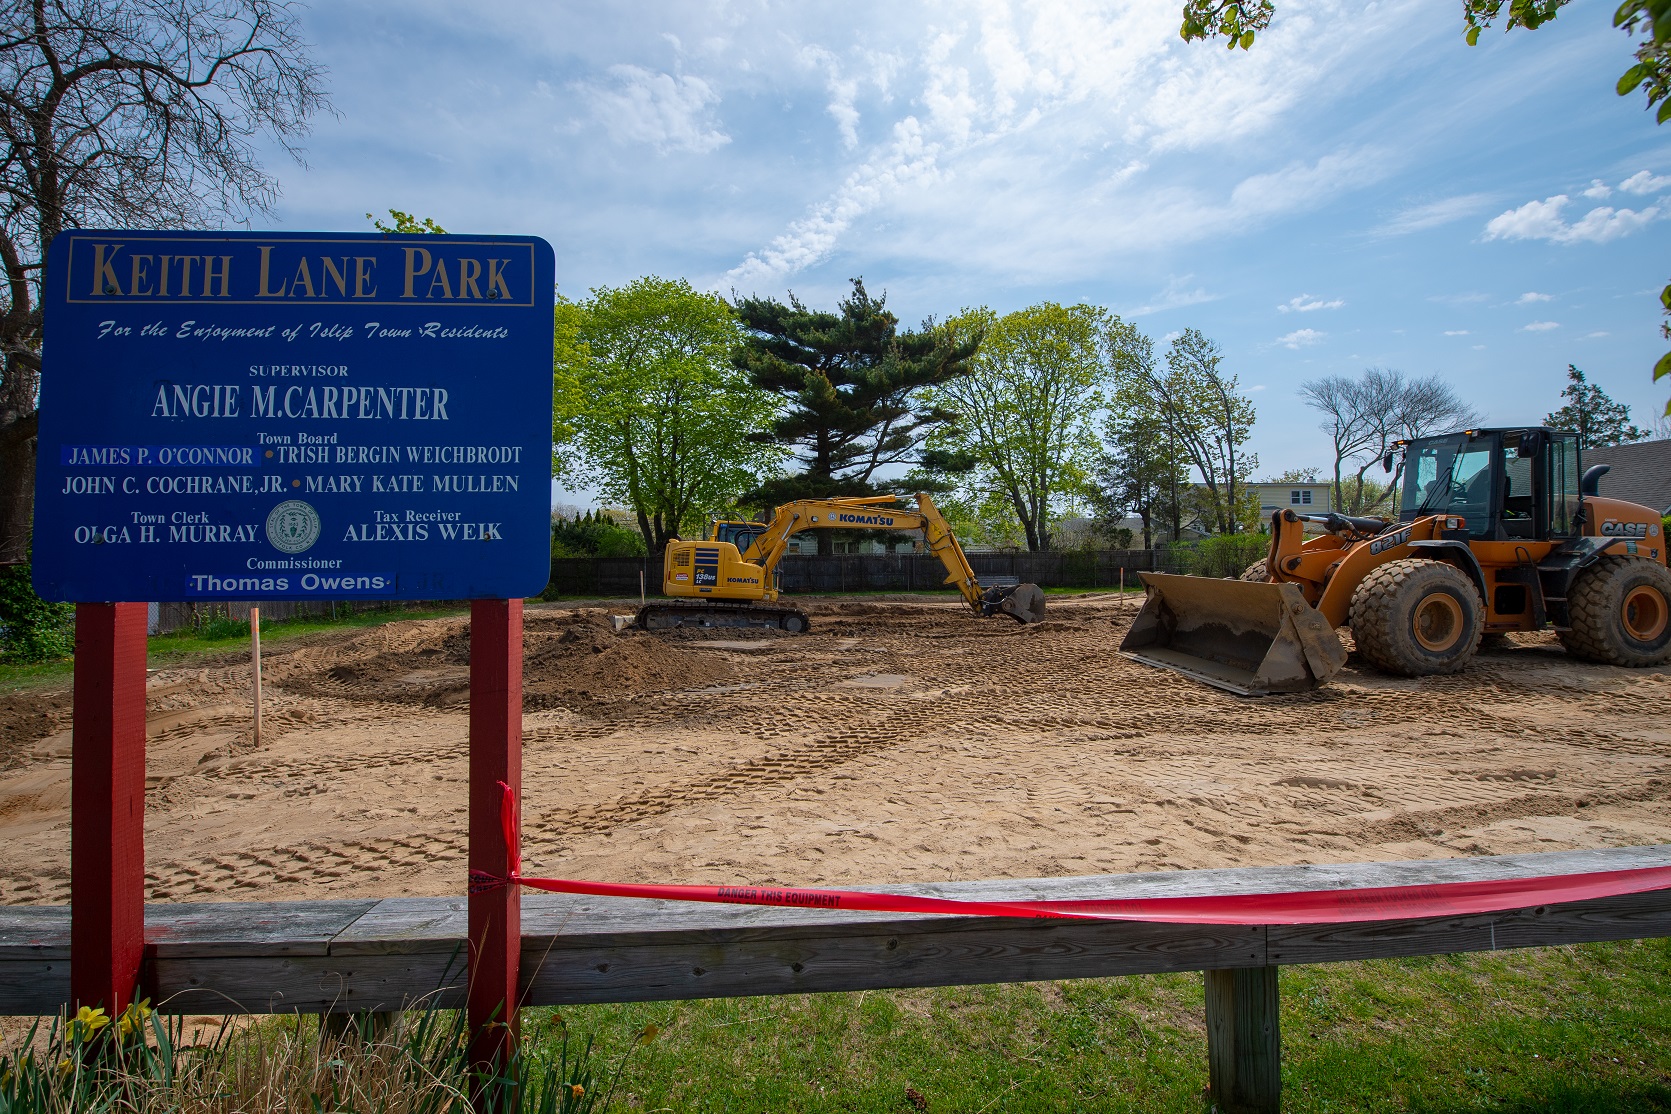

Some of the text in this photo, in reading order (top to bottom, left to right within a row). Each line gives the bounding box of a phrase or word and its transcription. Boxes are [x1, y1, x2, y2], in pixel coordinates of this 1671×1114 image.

[90, 244, 513, 300] KEITH LANE PARK
[97, 320, 509, 343] For the Enjoyment of Islip Town Residents
[249, 365, 349, 377] SUPERVISOR
[151, 384, 240, 418] ANGIE
[257, 432, 338, 445] Town Board
[69, 446, 523, 465] JAMES P. O'CONNOR TRISH BERGIN WEICHBRODT
[62, 476, 116, 495] JOHN
[123, 477, 140, 494] C.
[305, 475, 365, 493] MARY
[372, 475, 424, 492] KATE
[433, 475, 520, 493] MULLEN
[131, 511, 210, 524] Town Clerk
[374, 509, 461, 522] Tax Receiver
[840, 514, 893, 526] KOMATSU
[140, 525, 160, 543] H.
[169, 524, 259, 543] MURRAY
[343, 522, 503, 541] ALEXIS WEIK
[1601, 521, 1647, 537] CASE
[1370, 527, 1412, 555] 821F
[246, 557, 343, 570] Commissioner
[192, 573, 385, 591] Thomas Owens
[718, 888, 757, 899] DANGER
[761, 890, 782, 902] THIS
[785, 891, 841, 907] EQUIPMENT
